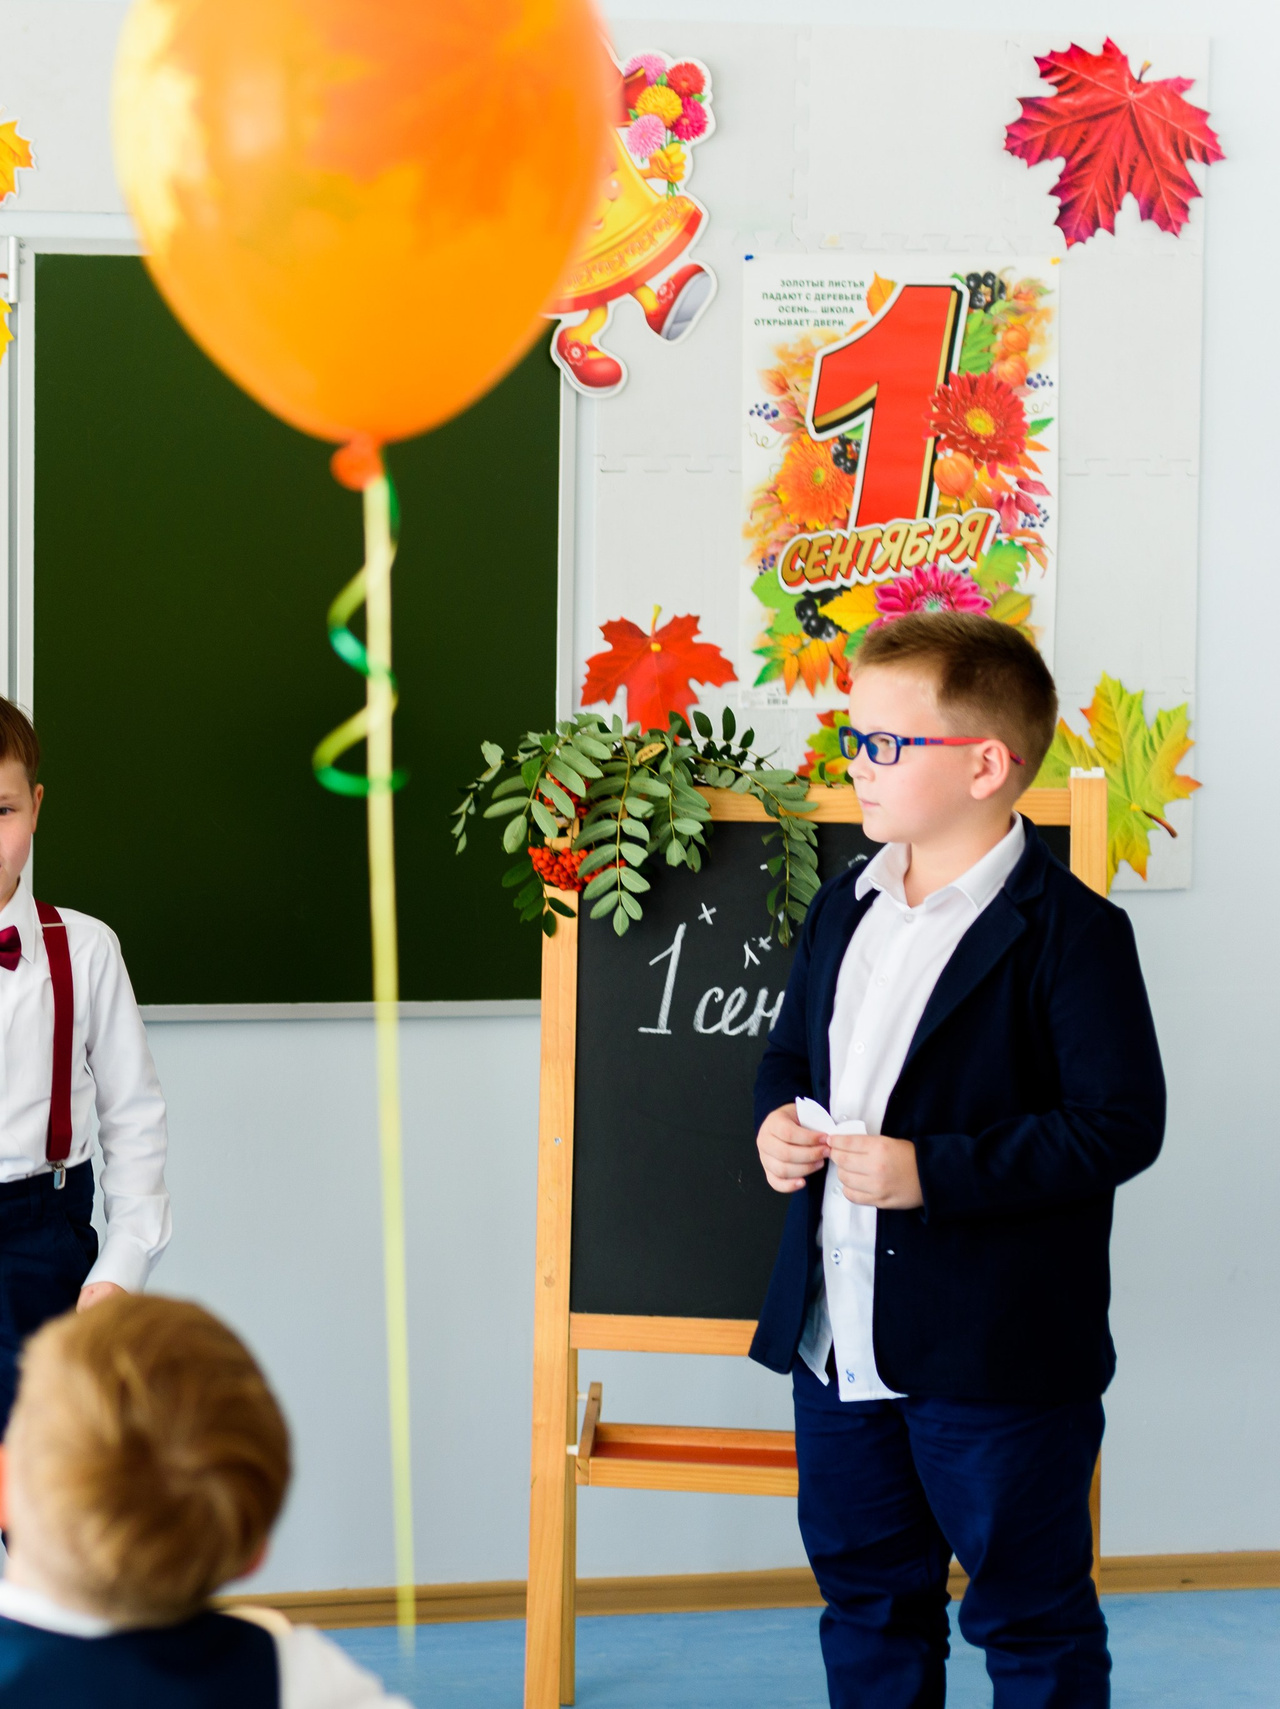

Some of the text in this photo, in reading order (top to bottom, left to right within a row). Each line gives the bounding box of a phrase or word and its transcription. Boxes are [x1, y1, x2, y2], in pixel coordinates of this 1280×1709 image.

[780, 280, 865, 288] ЗОЛОТЫЕ ЛИСТЬЯ
[762, 292, 802, 301] ПАДАЮТ
[805, 292, 812, 301] С
[821, 306, 855, 314] ШКОЛА
[754, 319, 810, 327] ОТКРЫВАЕТ
[812, 284, 963, 529] 1
[781, 511, 994, 587] СЕНТЯБРЯ
[637, 922, 687, 1036] 1
